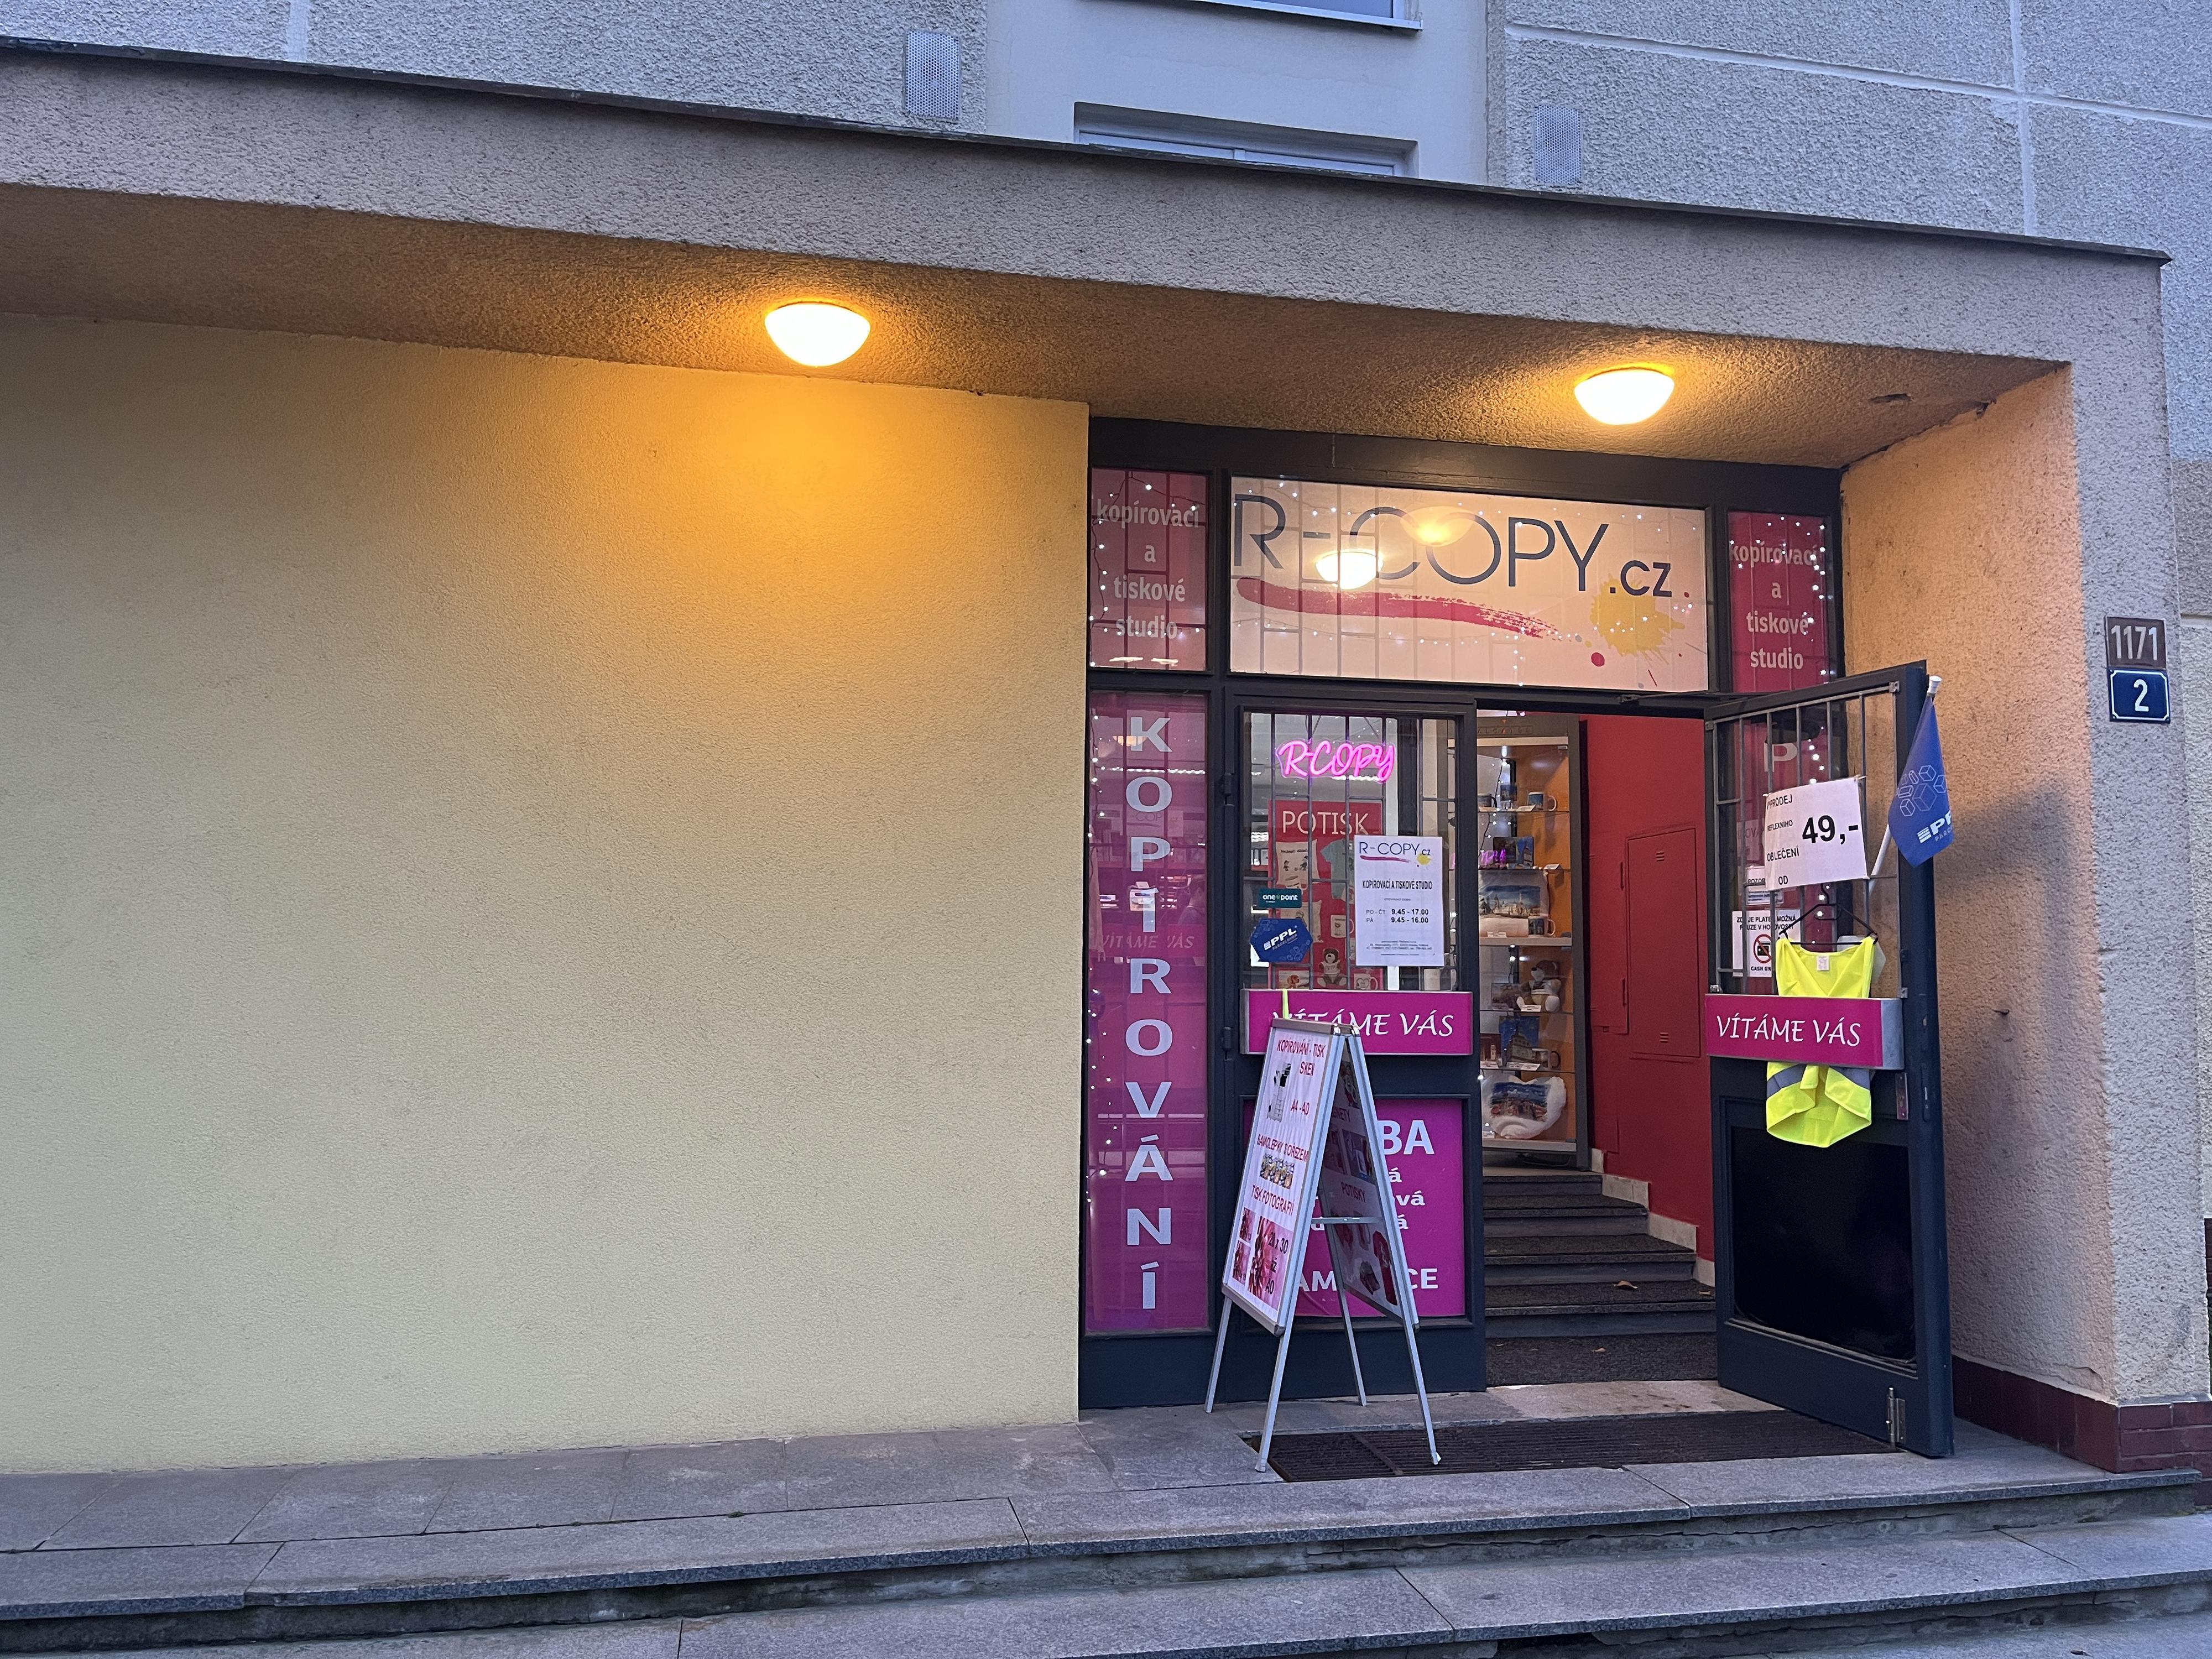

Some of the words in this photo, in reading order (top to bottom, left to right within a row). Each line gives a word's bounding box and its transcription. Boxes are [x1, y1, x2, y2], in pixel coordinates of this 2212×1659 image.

[1097, 499, 1199, 529] kopírovací
[1144, 542, 1156, 563] a
[1114, 576, 1185, 603] tiskové
[1771, 582, 1782, 598] a
[1115, 615, 1178, 640] studio
[1746, 611, 1809, 634] tiskové
[2111, 625, 2157, 661] 1171
[1750, 646, 1804, 669] studio
[2133, 679, 2149, 712] 2
[1282, 811, 1369, 836] POTISK
[1802, 815, 1859, 845] 49,-
[1767, 846, 1799, 862] OBLEČENÍ
[1362, 878, 1391, 889] KOPÍROVACÍ
[1391, 880, 1395, 889] A
[1395, 878, 1415, 890] TISKOVÉ
[1416, 880, 1432, 890] STUDIO
[1778, 875, 1788, 885] OD
[1270, 928, 1297, 947] PPL
[1400, 1010, 1454, 1037] VÁS
[1717, 1013, 1805, 1042] VÍTÁME
[1812, 1017, 1861, 1046] VÁS
[1277, 1037, 1311, 1056] KOPÍROVÁNÍ
[1313, 1044, 1326, 1058] TISK
[1251, 1185, 1263, 1201] TISK
[1280, 1237, 1288, 1254] 30
